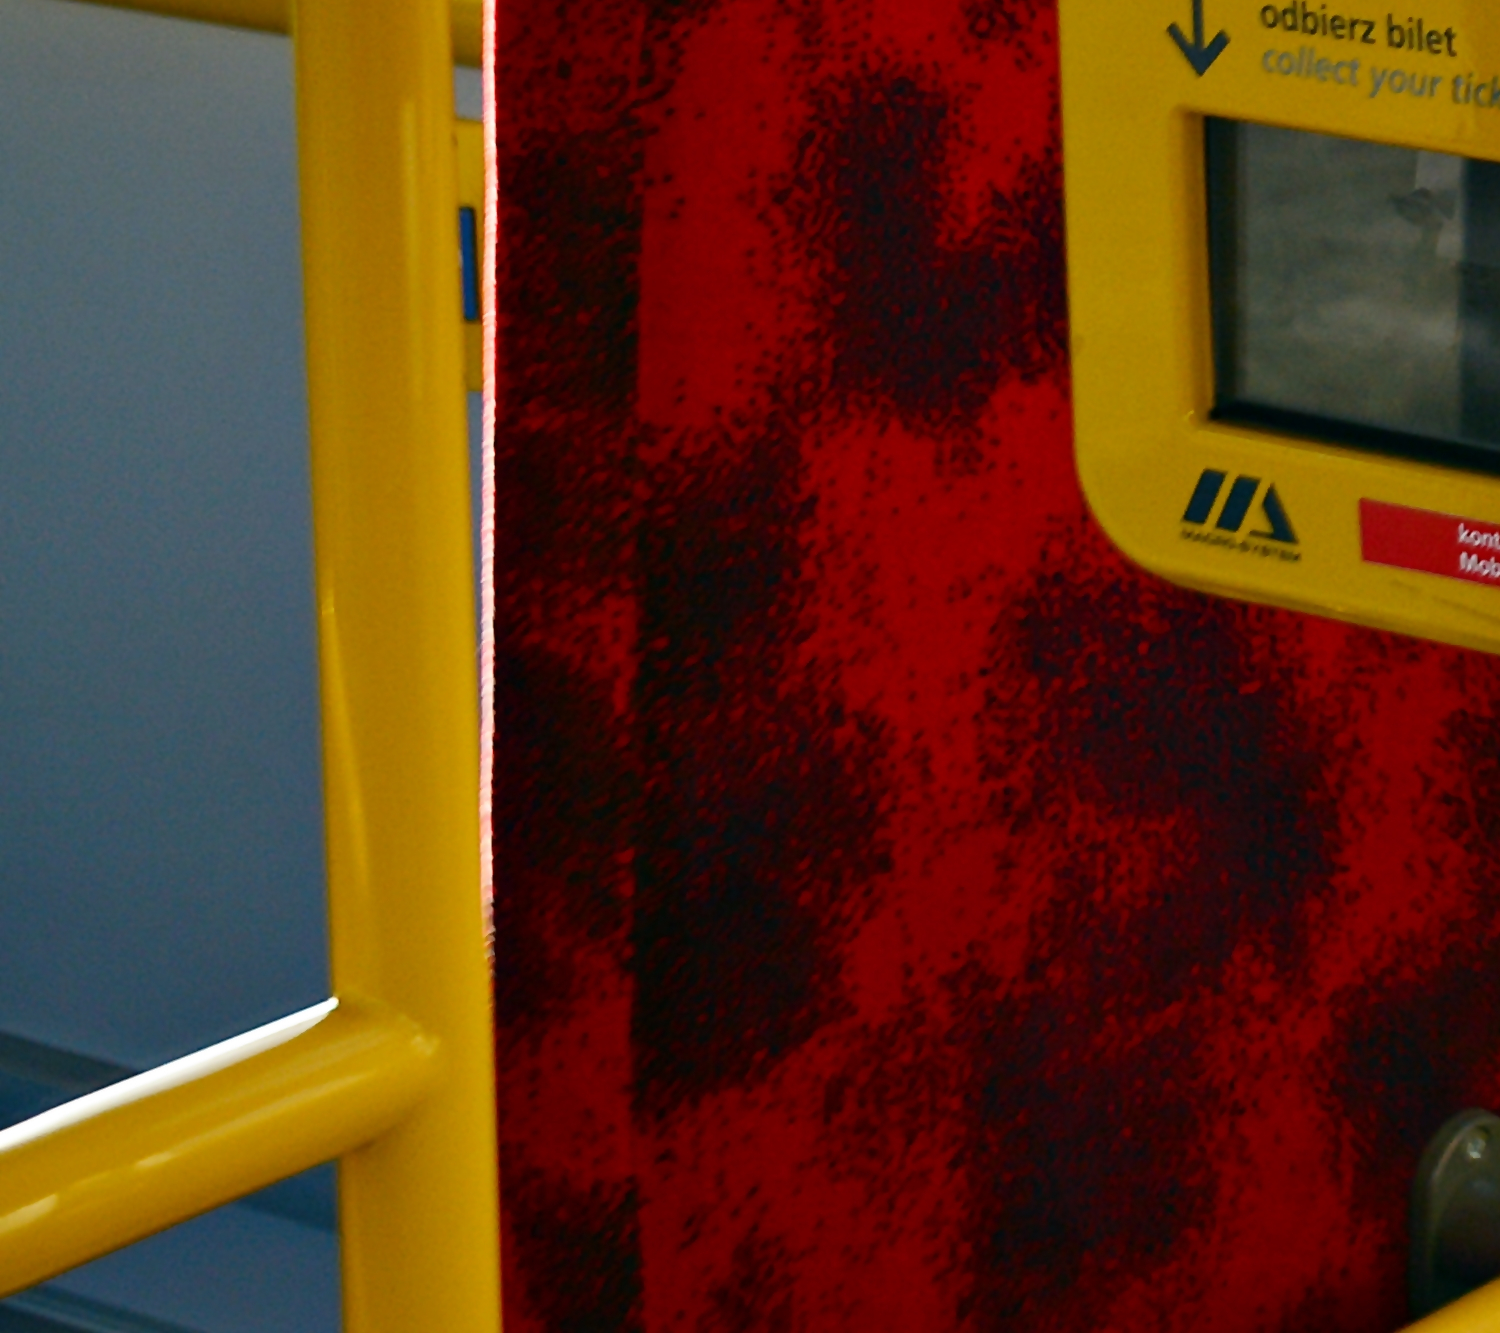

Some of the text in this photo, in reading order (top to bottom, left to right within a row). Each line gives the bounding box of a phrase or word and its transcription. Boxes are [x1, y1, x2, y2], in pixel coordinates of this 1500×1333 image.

[1260, 0, 1456, 58] odbierz bilet
[1262, 44, 1359, 86] collect
[1369, 67, 1439, 100] your
